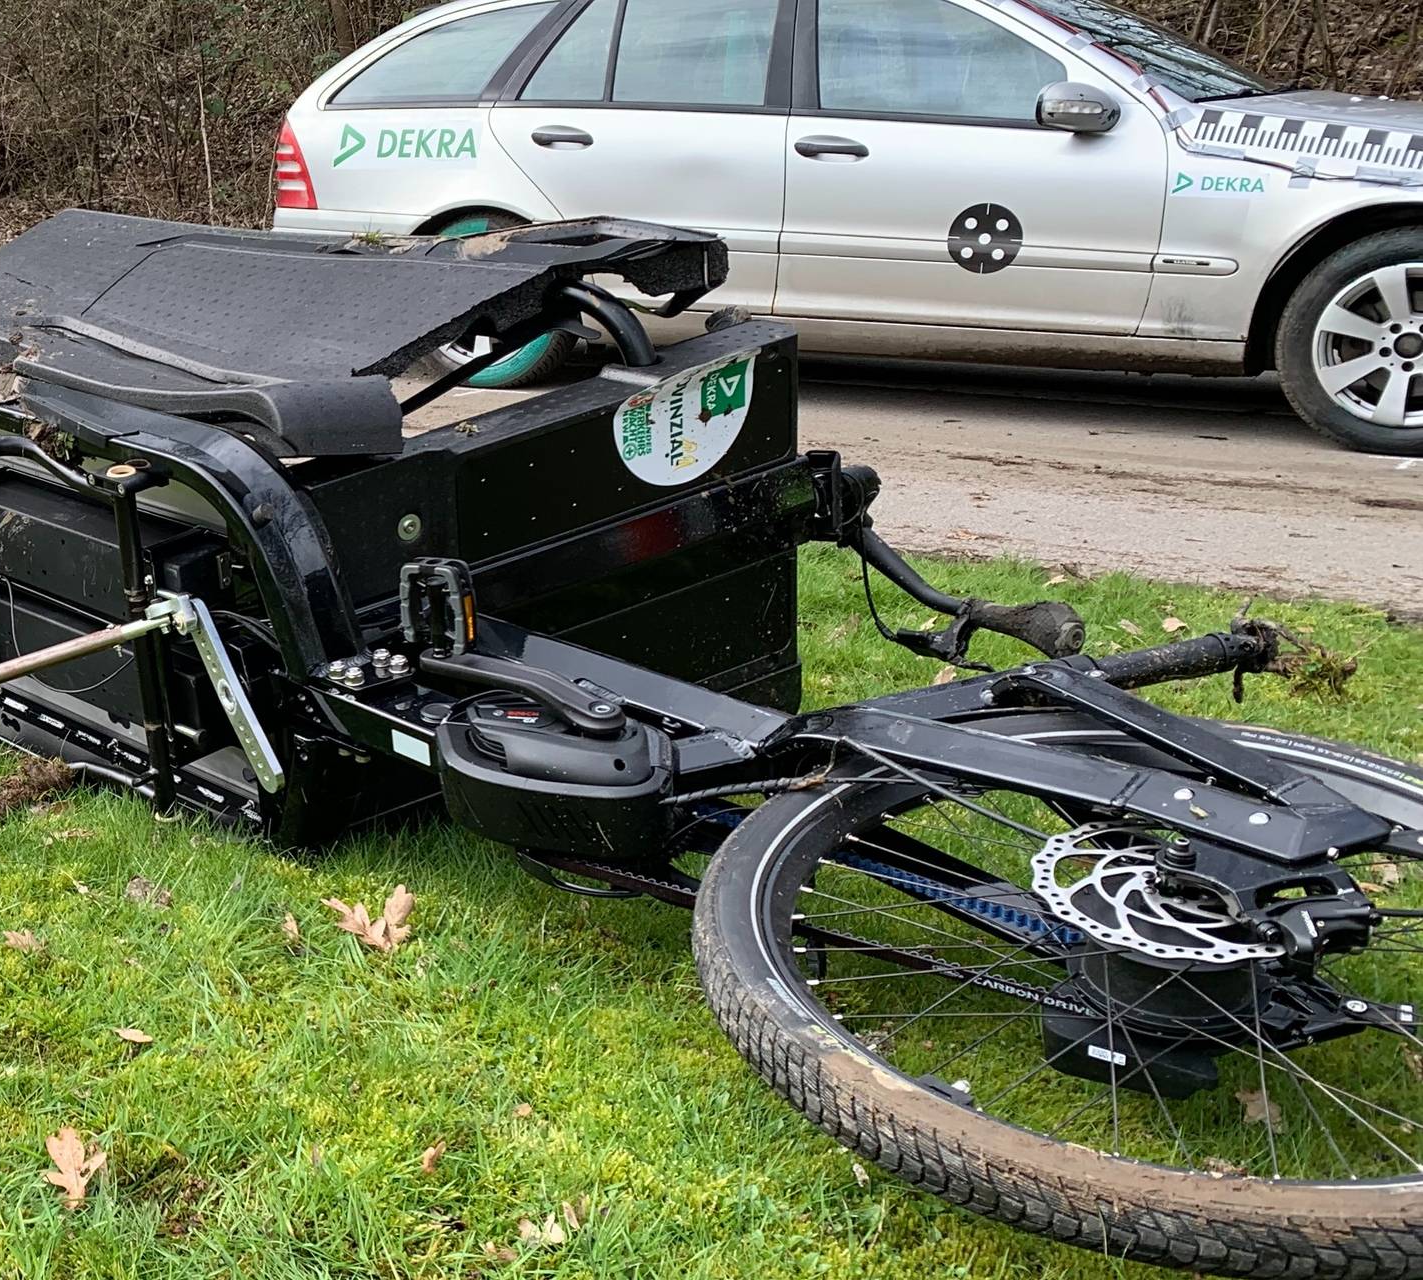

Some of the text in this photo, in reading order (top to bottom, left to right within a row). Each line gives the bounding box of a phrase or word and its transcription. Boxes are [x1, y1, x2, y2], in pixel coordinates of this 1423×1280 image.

[376, 128, 477, 158] DEKRA
[1200, 176, 1265, 193] DEKRA
[706, 373, 718, 410] DEKRA
[669, 374, 692, 466] OVINZIAL
[973, 977, 1097, 1018] CARBON DRIVE
